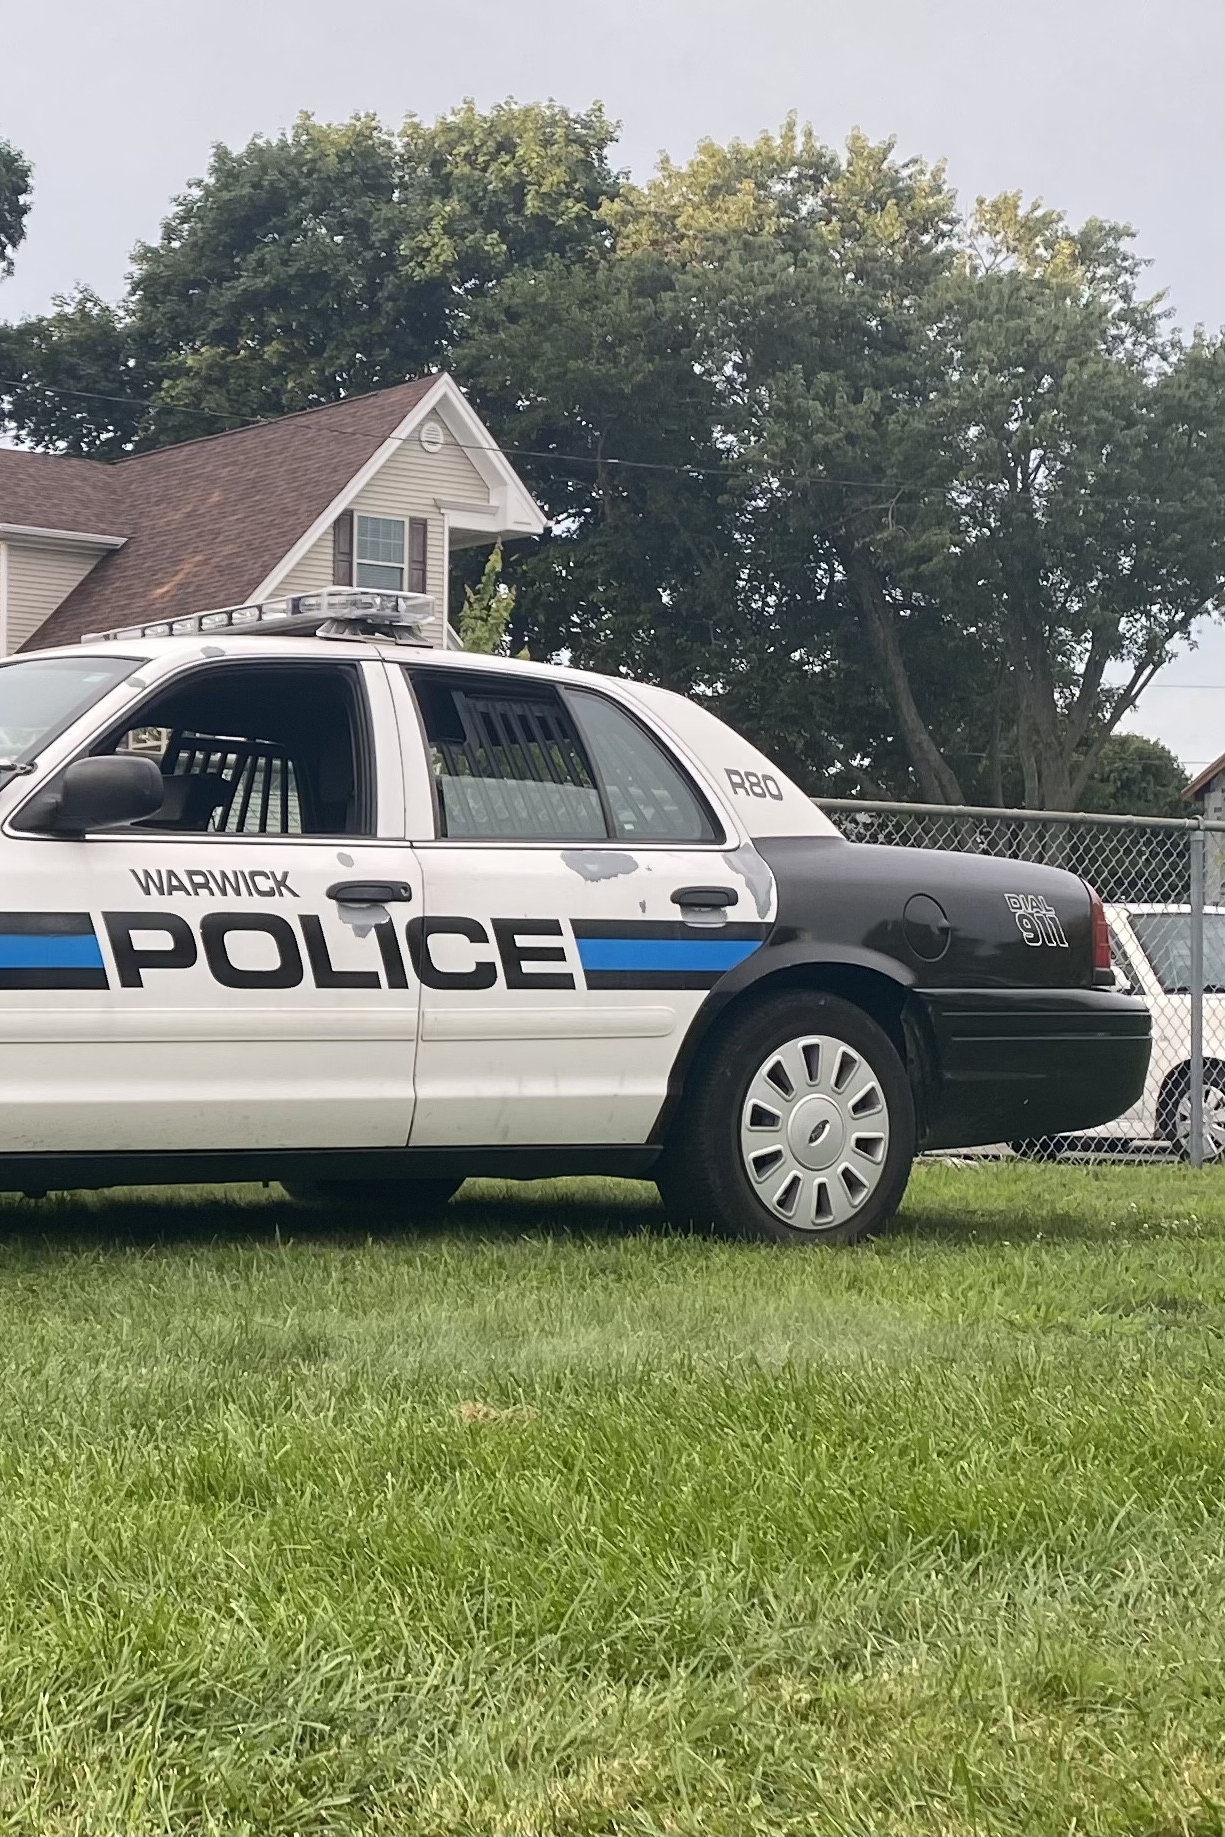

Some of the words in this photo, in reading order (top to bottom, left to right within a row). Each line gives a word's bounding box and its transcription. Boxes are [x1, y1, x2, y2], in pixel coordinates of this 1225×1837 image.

[724, 768, 783, 801] R80
[129, 868, 300, 898] WARWICK
[1004, 893, 1056, 914] DIAL
[1015, 911, 1069, 948] 911
[102, 911, 576, 991] POLICE
